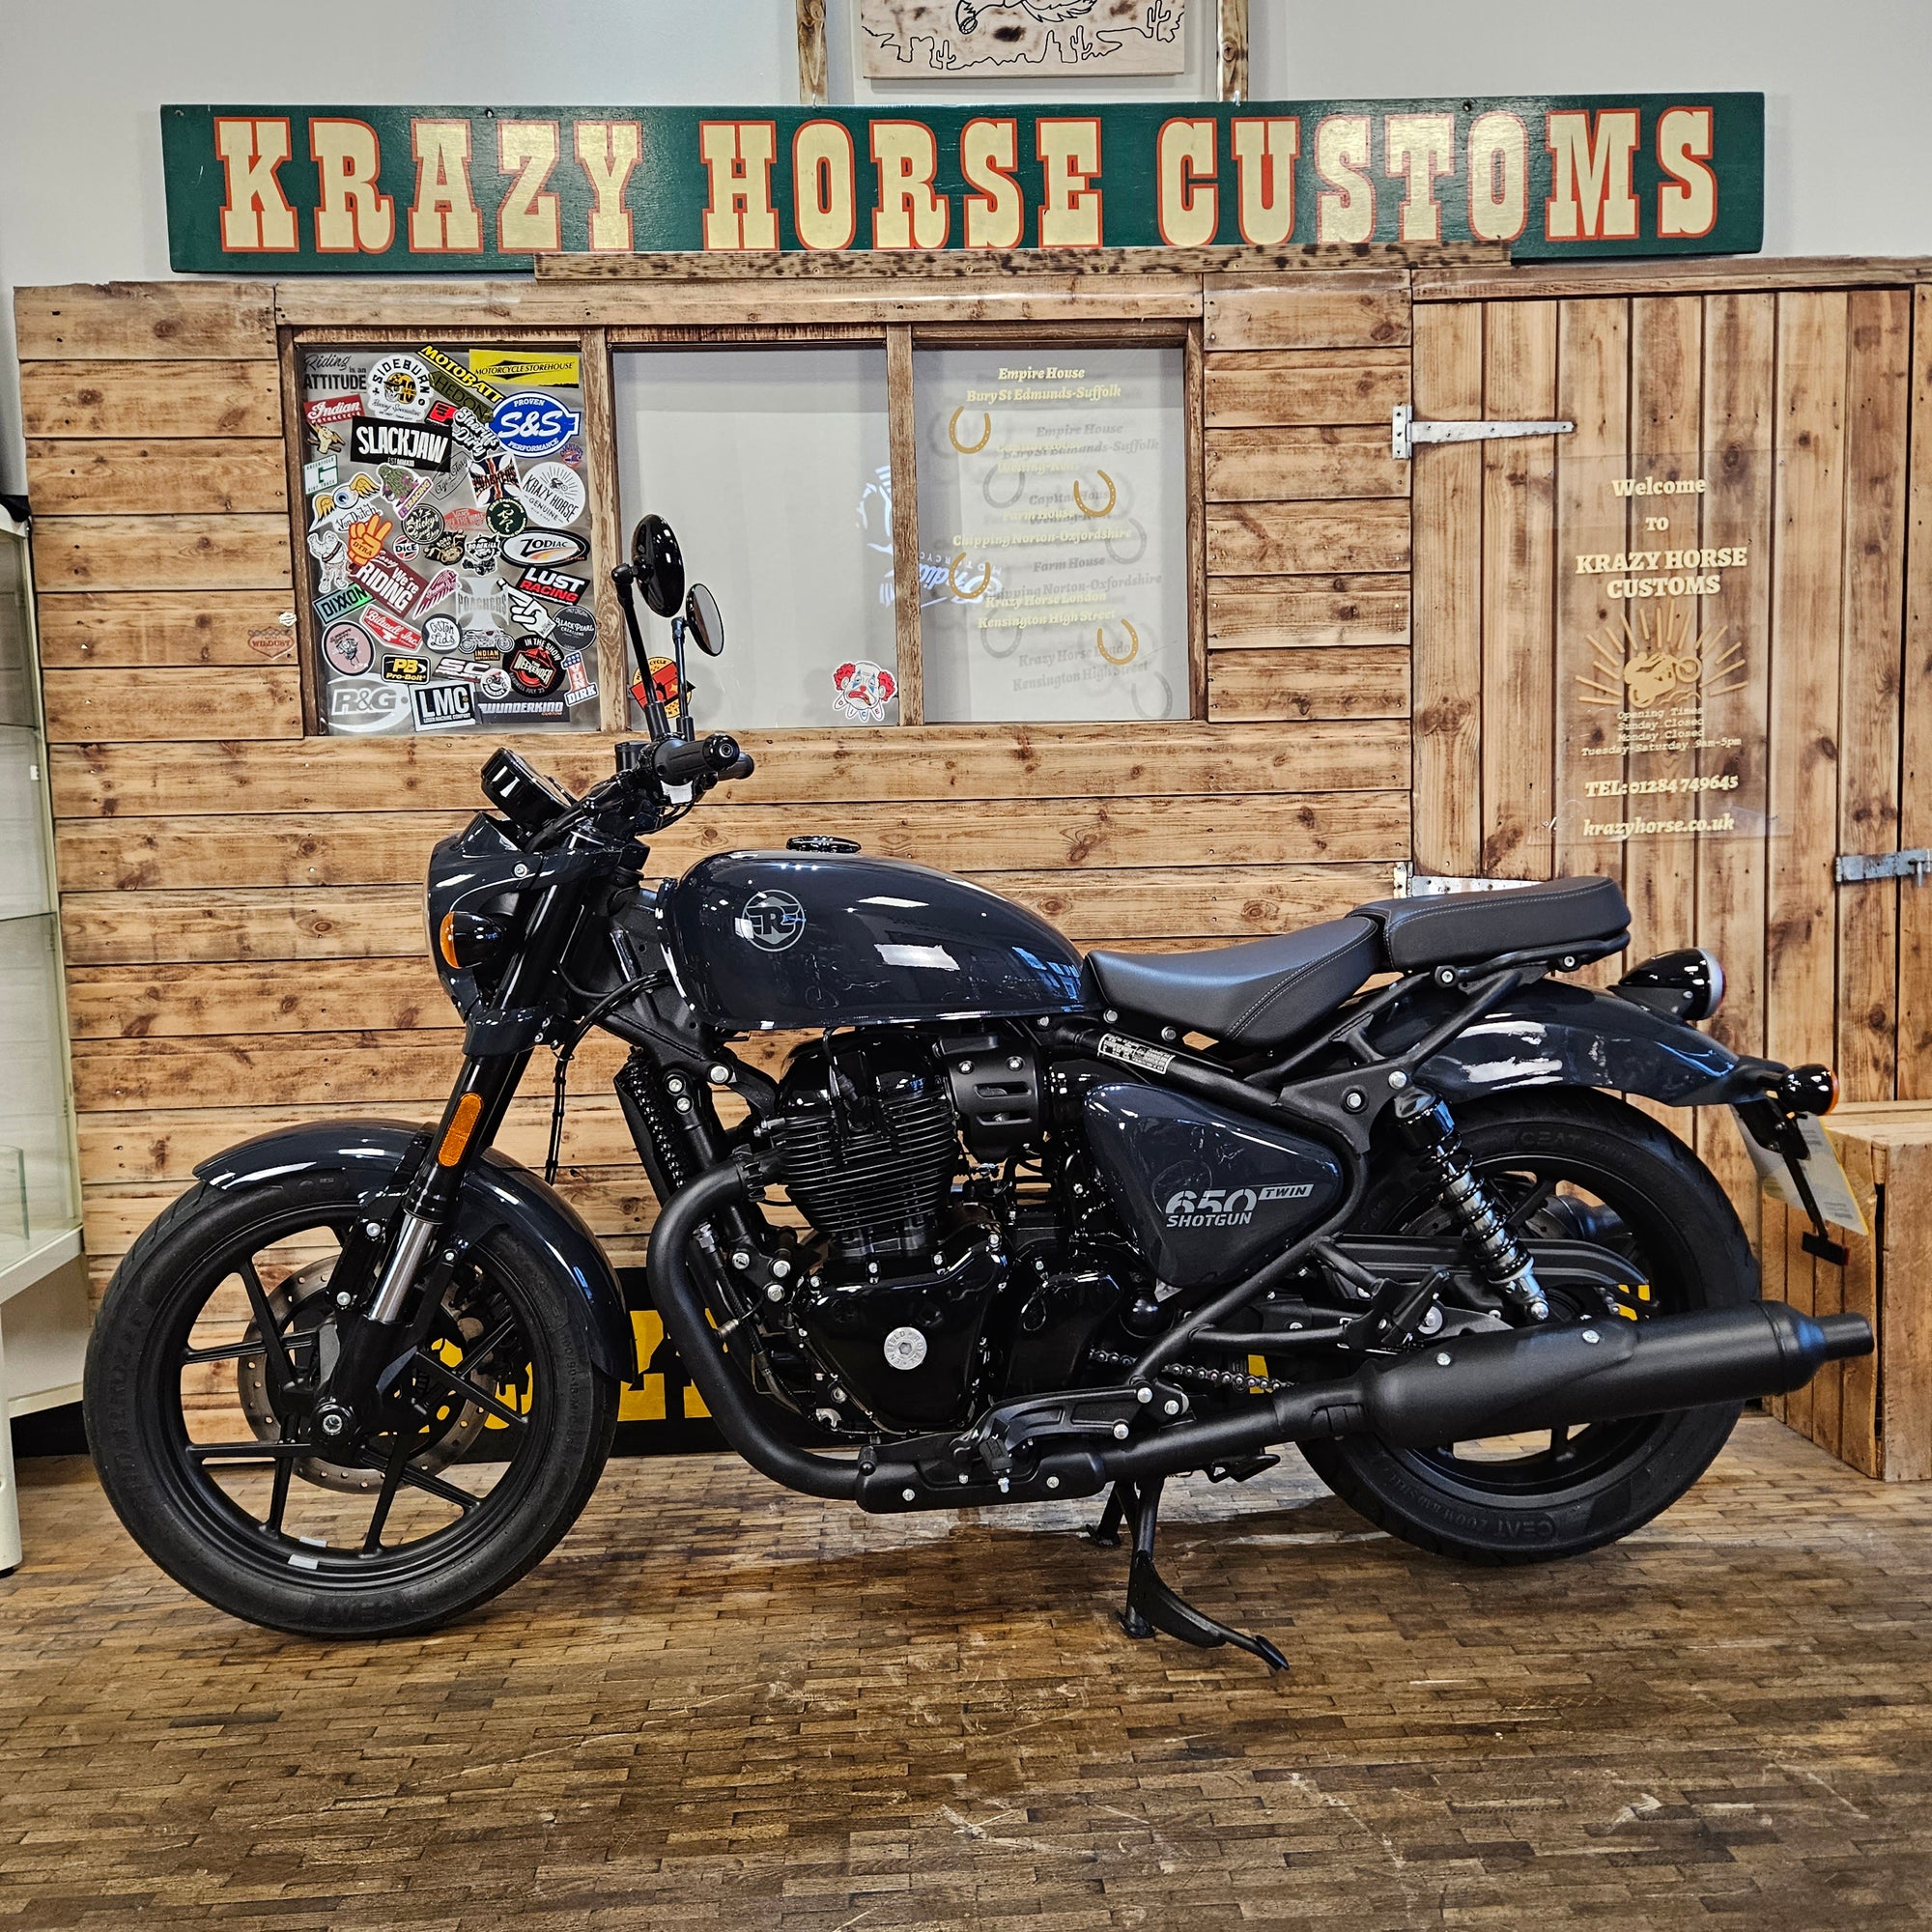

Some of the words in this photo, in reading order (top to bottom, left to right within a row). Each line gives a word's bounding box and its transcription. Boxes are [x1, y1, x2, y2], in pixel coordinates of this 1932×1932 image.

[213, 117, 641, 253] KRAZY
[698, 116, 1103, 252] HORSE
[1158, 105, 1719, 246] CUSTOMS
[304, 354, 352, 371] Riding
[474, 365, 526, 376] MOTORCYCLE
[525, 362, 574, 372] STOREHOUSE
[304, 374, 367, 390] ATTITUDE
[372, 358, 430, 394] SIDEBURN
[421, 346, 503, 404] MOTOBATT
[999, 367, 1045, 383] Empire
[1046, 366, 1086, 380] House
[435, 376, 487, 419] HEDON
[514, 399, 546, 408] PROVEN
[966, 389, 997, 405] Bury
[999, 388, 1012, 401] St
[1013, 384, 1122, 402] Edmunds-Suffolk
[308, 401, 362, 420] Indian
[497, 410, 564, 439] S&S
[355, 426, 449, 464] SLACKJAW
[507, 437, 559, 452] PERFORMANCE
[1611, 475, 1707, 497] Welcome
[522, 474, 551, 503] KRAZY
[549, 495, 580, 524] HORSE
[528, 497, 559, 522] GENUINE
[1645, 517, 1669, 531] TO
[520, 538, 569, 558] ZODIAC
[952, 533, 1011, 548] Chipping
[1011, 529, 1133, 545] Norton-Oxfordshire
[353, 541, 373, 556] DTRA
[1033, 560, 1069, 573] Farm
[1070, 556, 1106, 571] House
[1576, 551, 1662, 575] KRAZY
[1664, 547, 1748, 570] HORSE
[355, 562, 414, 611] RIDING
[392, 567, 419, 594] We're
[525, 568, 585, 593] LUST
[1606, 575, 1721, 599] CUSTOMS
[519, 580, 579, 602] RACING
[984, 595, 1022, 610] Krazy
[1023, 593, 1060, 606] Horse
[1061, 591, 1107, 604] London
[320, 586, 368, 617] DIXXON
[555, 617, 577, 630] BLACK
[978, 614, 1048, 629] Kensington
[1049, 611, 1079, 625] High
[1080, 609, 1116, 621] Street
[474, 649, 499, 658] INDIAN
[532, 639, 547, 650] THE
[391, 658, 418, 674] PB
[438, 658, 492, 675] SC
[514, 653, 554, 685] WEEKENDER
[385, 671, 425, 681] Pro-Bolt
[333, 687, 398, 714] R&G
[419, 686, 470, 719] LMC
[567, 684, 597, 704] DIRK
[478, 701, 564, 714] WUNDERKIND
[1617, 709, 1665, 721] Opening
[1670, 707, 1704, 716] Times
[1617, 720, 1659, 732] Sunday
[1664, 718, 1705, 727] Closed
[1617, 731, 1660, 743] Monday
[1664, 728, 1705, 739] Closed
[1581, 740, 1689, 756] Tuesday-Saturday
[1680, 775, 1739, 794] 749645
[1583, 812, 1735, 840] krazyhorse.co.uk
[1165, 1188, 1258, 1214] 650
[1264, 1185, 1308, 1198] TWIN
[1166, 1211, 1253, 1228] SHOTGUN
